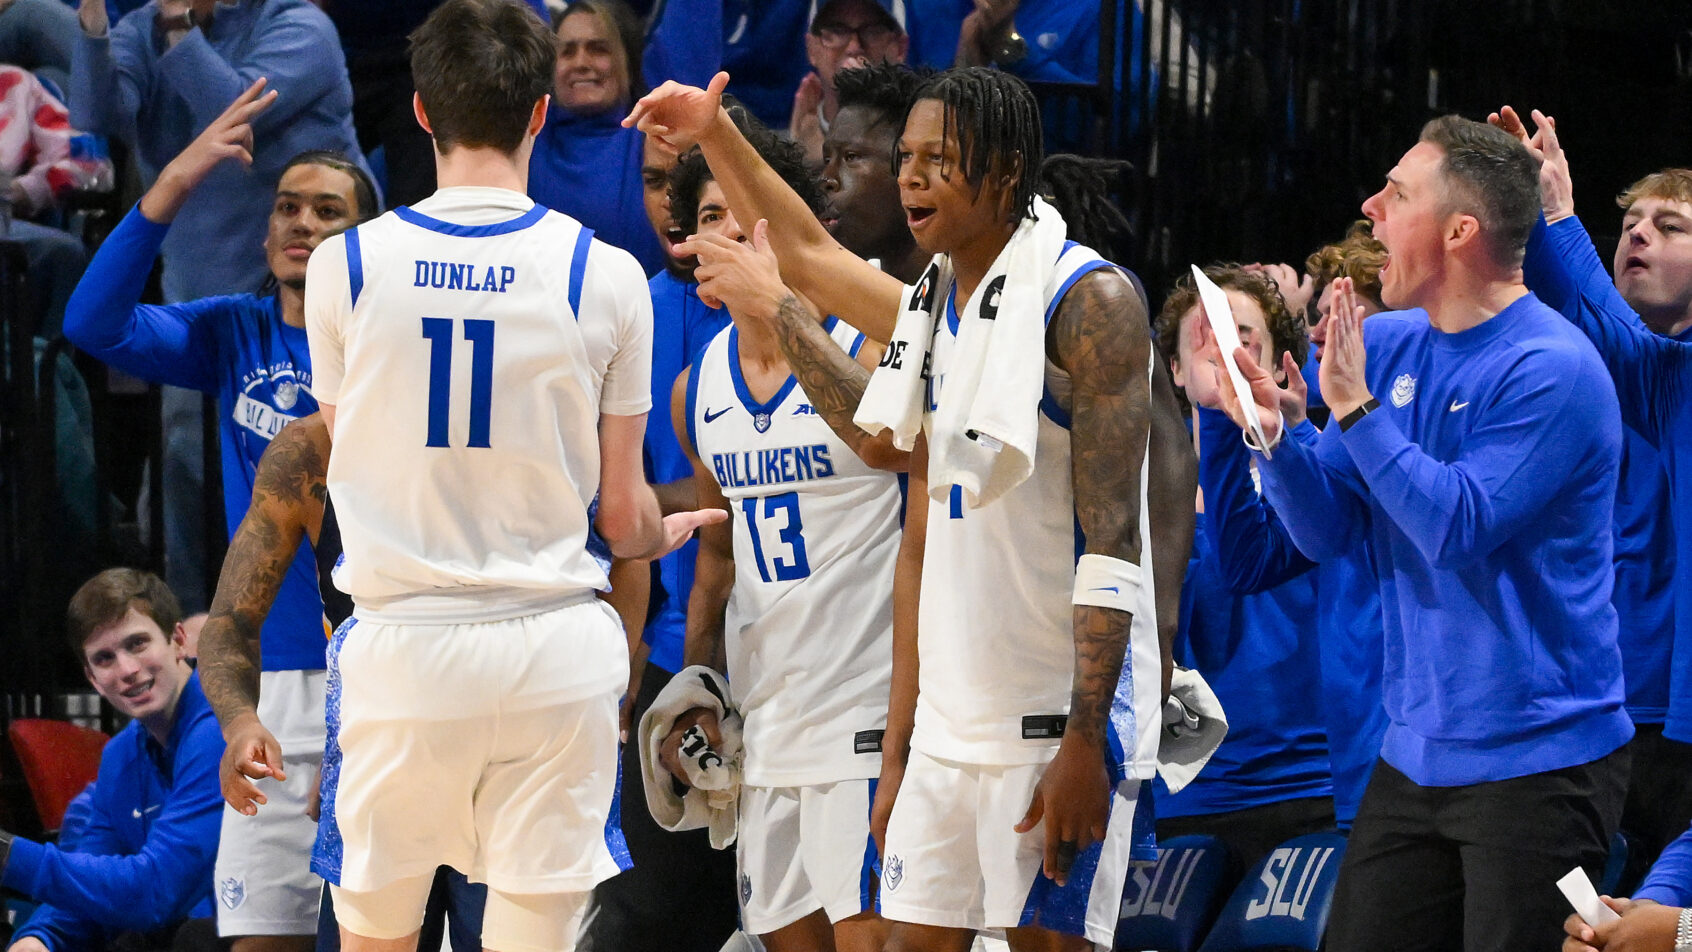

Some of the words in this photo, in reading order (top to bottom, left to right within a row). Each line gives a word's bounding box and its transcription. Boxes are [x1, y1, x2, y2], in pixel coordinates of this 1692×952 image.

[414, 260, 515, 293] DUNLAP
[421, 317, 496, 449] 11
[711, 444, 836, 488] BILLIKENS
[742, 491, 811, 583] 13
[1120, 848, 1206, 921] SLU
[1245, 847, 1335, 921] SLU
